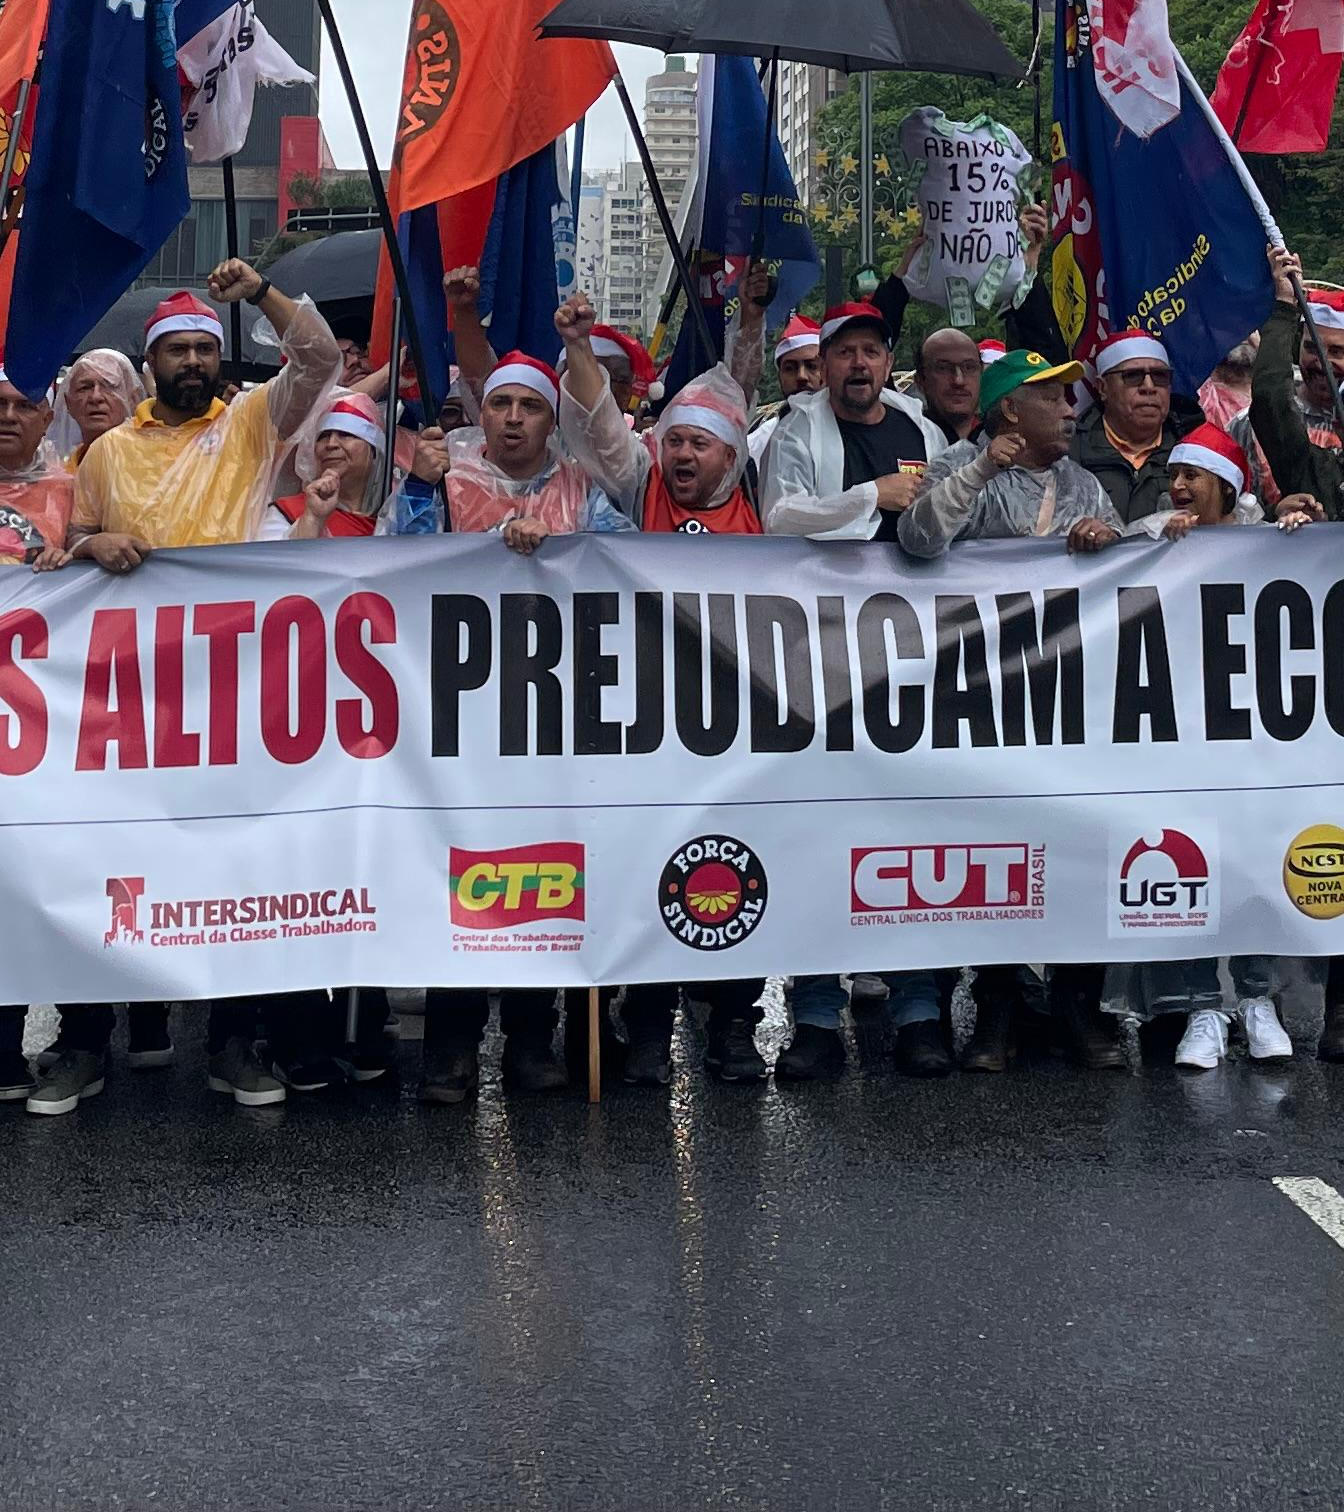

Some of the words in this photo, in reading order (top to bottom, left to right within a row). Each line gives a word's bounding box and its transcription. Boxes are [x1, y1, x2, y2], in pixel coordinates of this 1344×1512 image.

[924, 137, 1005, 158] ABAIXO
[948, 161, 1009, 193] 15%
[928, 201, 952, 222] DE
[940, 228, 991, 264] NÃO
[74, 591, 400, 772] ALTOS
[430, 588, 1085, 758] PREJUDICAM
[1111, 586, 1179, 744] A
[673, 839, 750, 874] FORÇA
[457, 861, 578, 911] CTB
[854, 847, 1026, 908] CUT
[1031, 843, 1045, 906] BRASIL
[1308, 881, 1342, 893] NOVA
[150, 888, 376, 929] INTERSINDICAL
[1120, 879, 1207, 909] UGT
[151, 931, 205, 947] Central
[208, 930, 226, 944] da
[230, 927, 277, 942] Classe
[280, 918, 376, 938] Trabalhadora
[663, 898, 763, 946] SINDICAL
[850, 911, 897, 926] CENTRAL
[899, 910, 931, 924] ÚNICA
[932, 912, 953, 922] DOS
[956, 909, 1044, 922] TRABALHADORES
[453, 934, 488, 942] Central
[491, 934, 509, 942] dos
[512, 933, 584, 942] Trabalhadores
[463, 943, 532, 952] Trabalhadoras
[535, 944, 547, 952] do
[550, 943, 581, 952] Brasil
